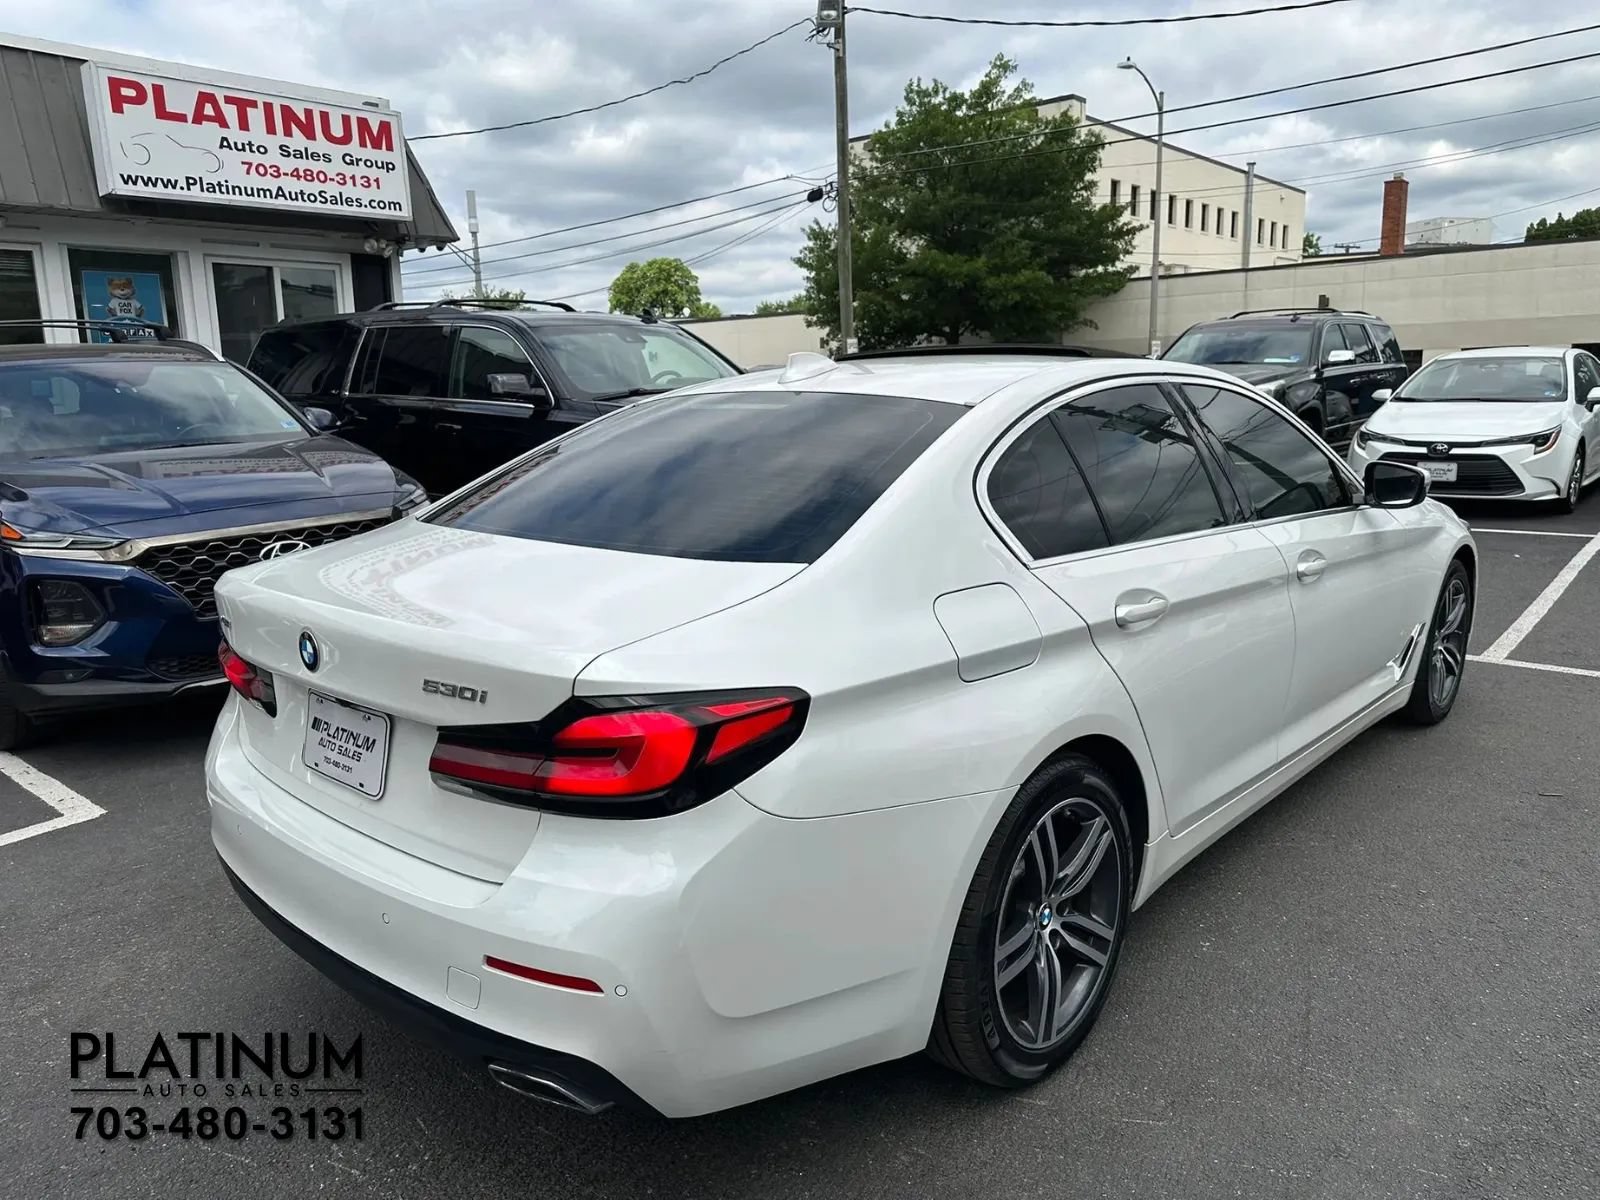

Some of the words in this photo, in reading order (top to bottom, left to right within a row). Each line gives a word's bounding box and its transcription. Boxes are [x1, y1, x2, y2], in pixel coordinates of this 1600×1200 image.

[107, 76, 394, 152] PLATINUM
[218, 136, 268, 155] Auto
[278, 144, 332, 164] Sales
[341, 153, 396, 173] Group
[119, 172, 403, 212] www.PlatinumAutoSales.com
[241, 161, 382, 190] 703-480-3131
[422, 678, 488, 704] 530i
[318, 736, 337, 752] AUTO
[337, 745, 363, 763] SALES
[320, 719, 377, 753] PLATINUM
